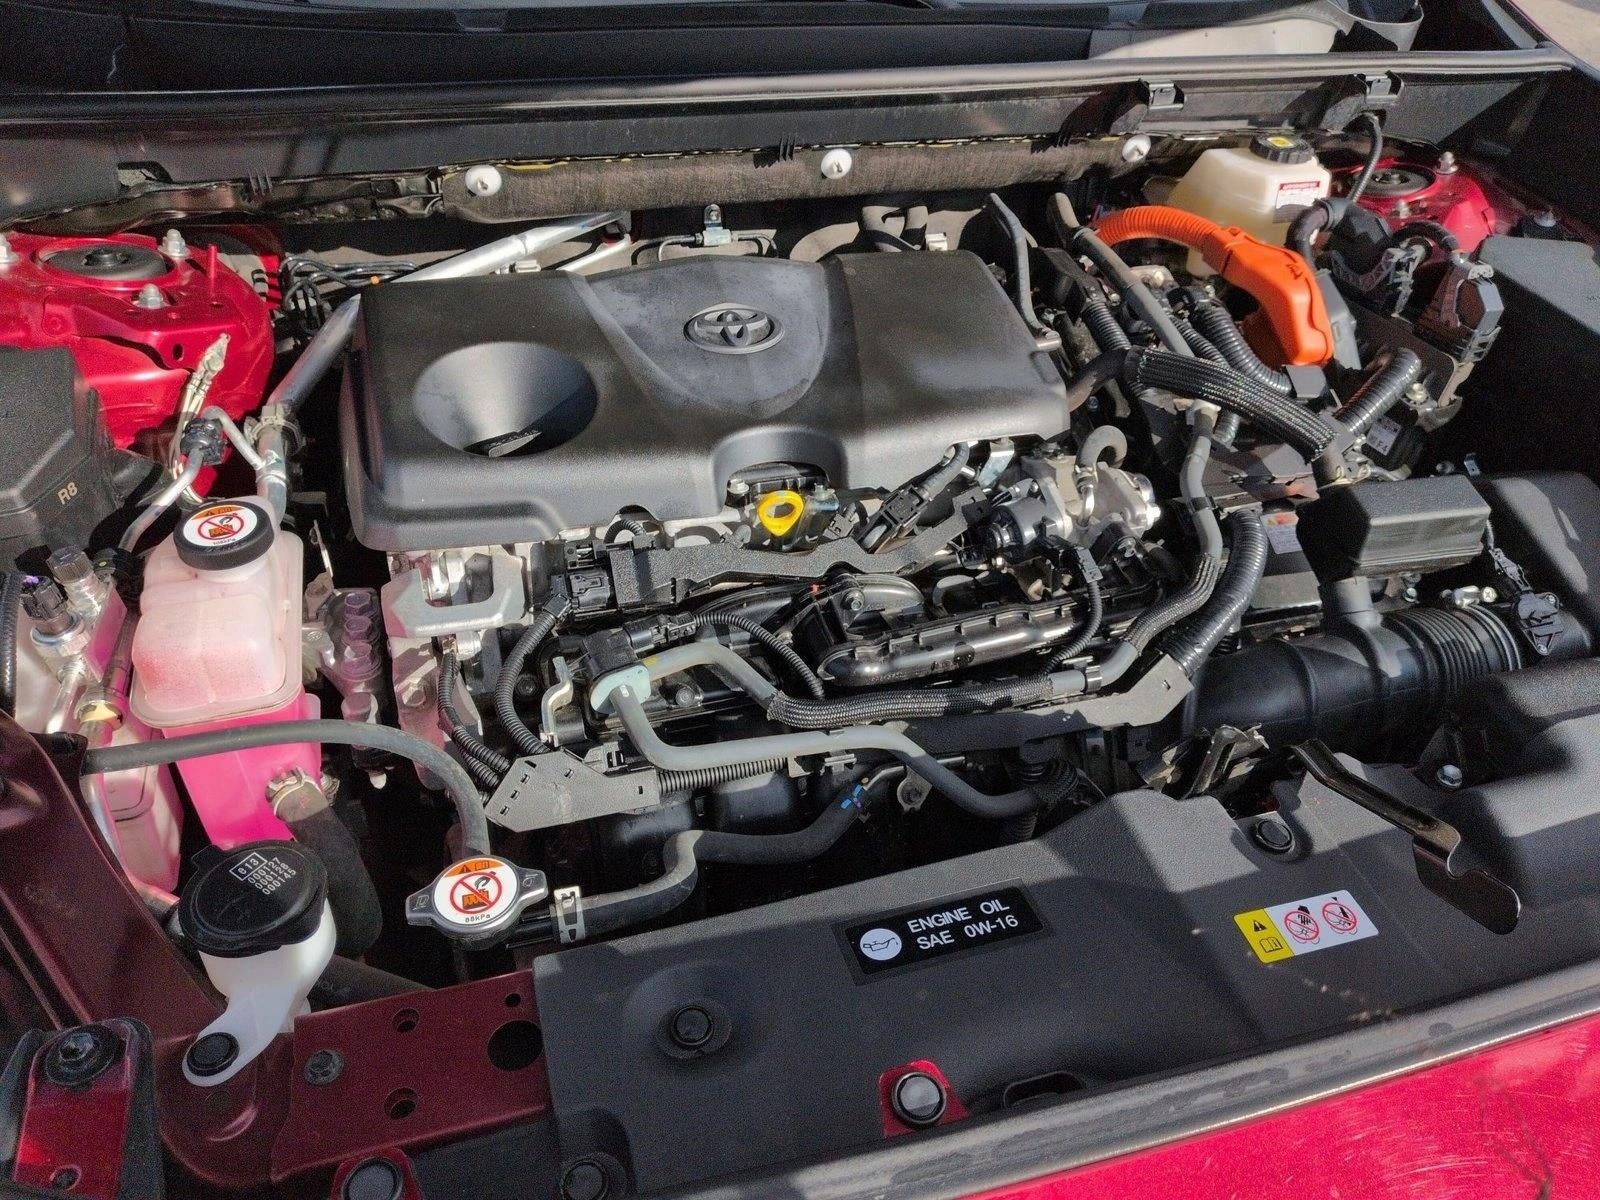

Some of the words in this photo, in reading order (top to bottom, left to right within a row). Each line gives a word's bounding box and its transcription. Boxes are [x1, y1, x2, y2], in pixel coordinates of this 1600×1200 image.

[58, 482, 78, 505] R8
[247, 857, 281, 884] 000127
[254, 862, 289, 890] 000128
[262, 868, 296, 895] 000145
[907, 907, 972, 933] ENGINE
[980, 899, 1010, 914] OIL
[916, 930, 955, 950] SAE
[963, 914, 1019, 938] 0W-16
